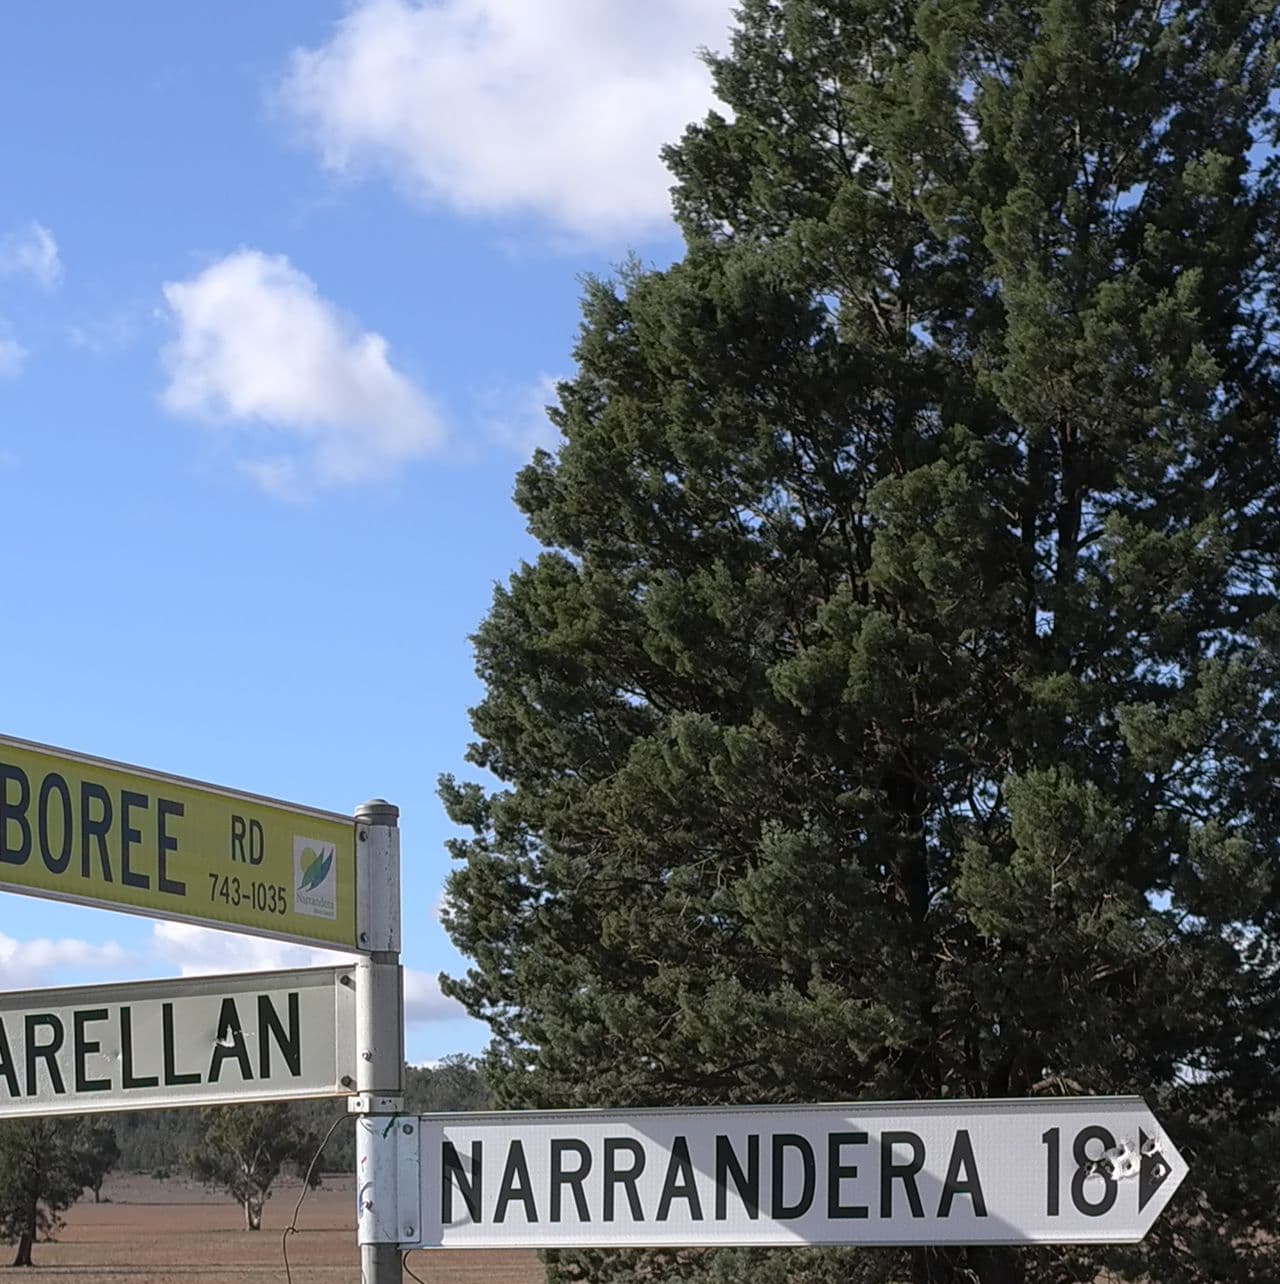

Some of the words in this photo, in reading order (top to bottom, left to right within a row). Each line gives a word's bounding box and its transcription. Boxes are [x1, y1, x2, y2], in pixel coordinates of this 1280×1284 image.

[230, 814, 265, 866] RD
[208, 872, 288, 916] 743-1035
[440, 1128, 988, 1226] NARRANDERA
[1042, 1125, 1118, 1217] 18
